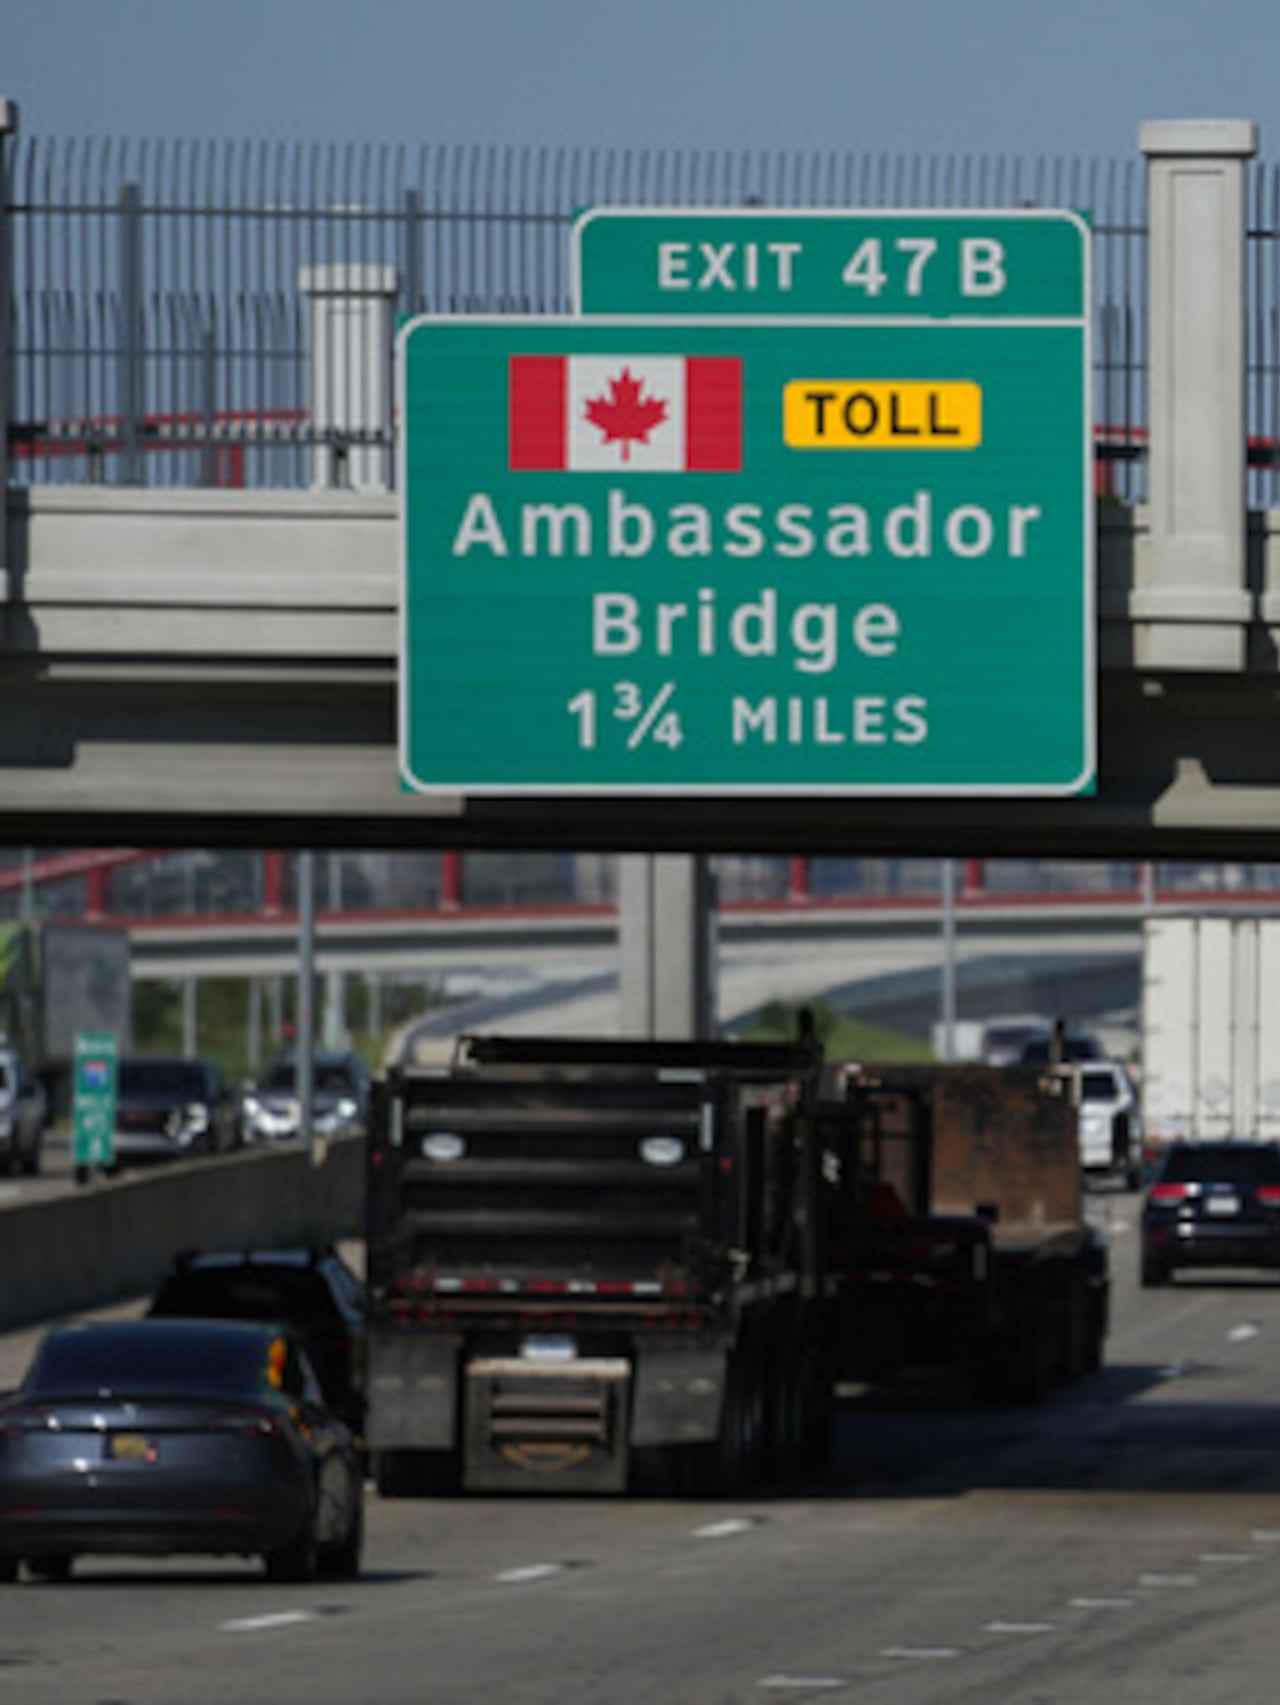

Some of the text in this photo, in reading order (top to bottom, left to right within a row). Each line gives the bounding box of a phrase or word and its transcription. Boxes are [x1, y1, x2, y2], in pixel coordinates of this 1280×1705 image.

[656, 242, 803, 291] EXIT
[804, 392, 961, 436] TOLL
[450, 490, 1042, 559] Ambassador
[591, 587, 902, 673] Bridge
[731, 696, 930, 745] MILES
